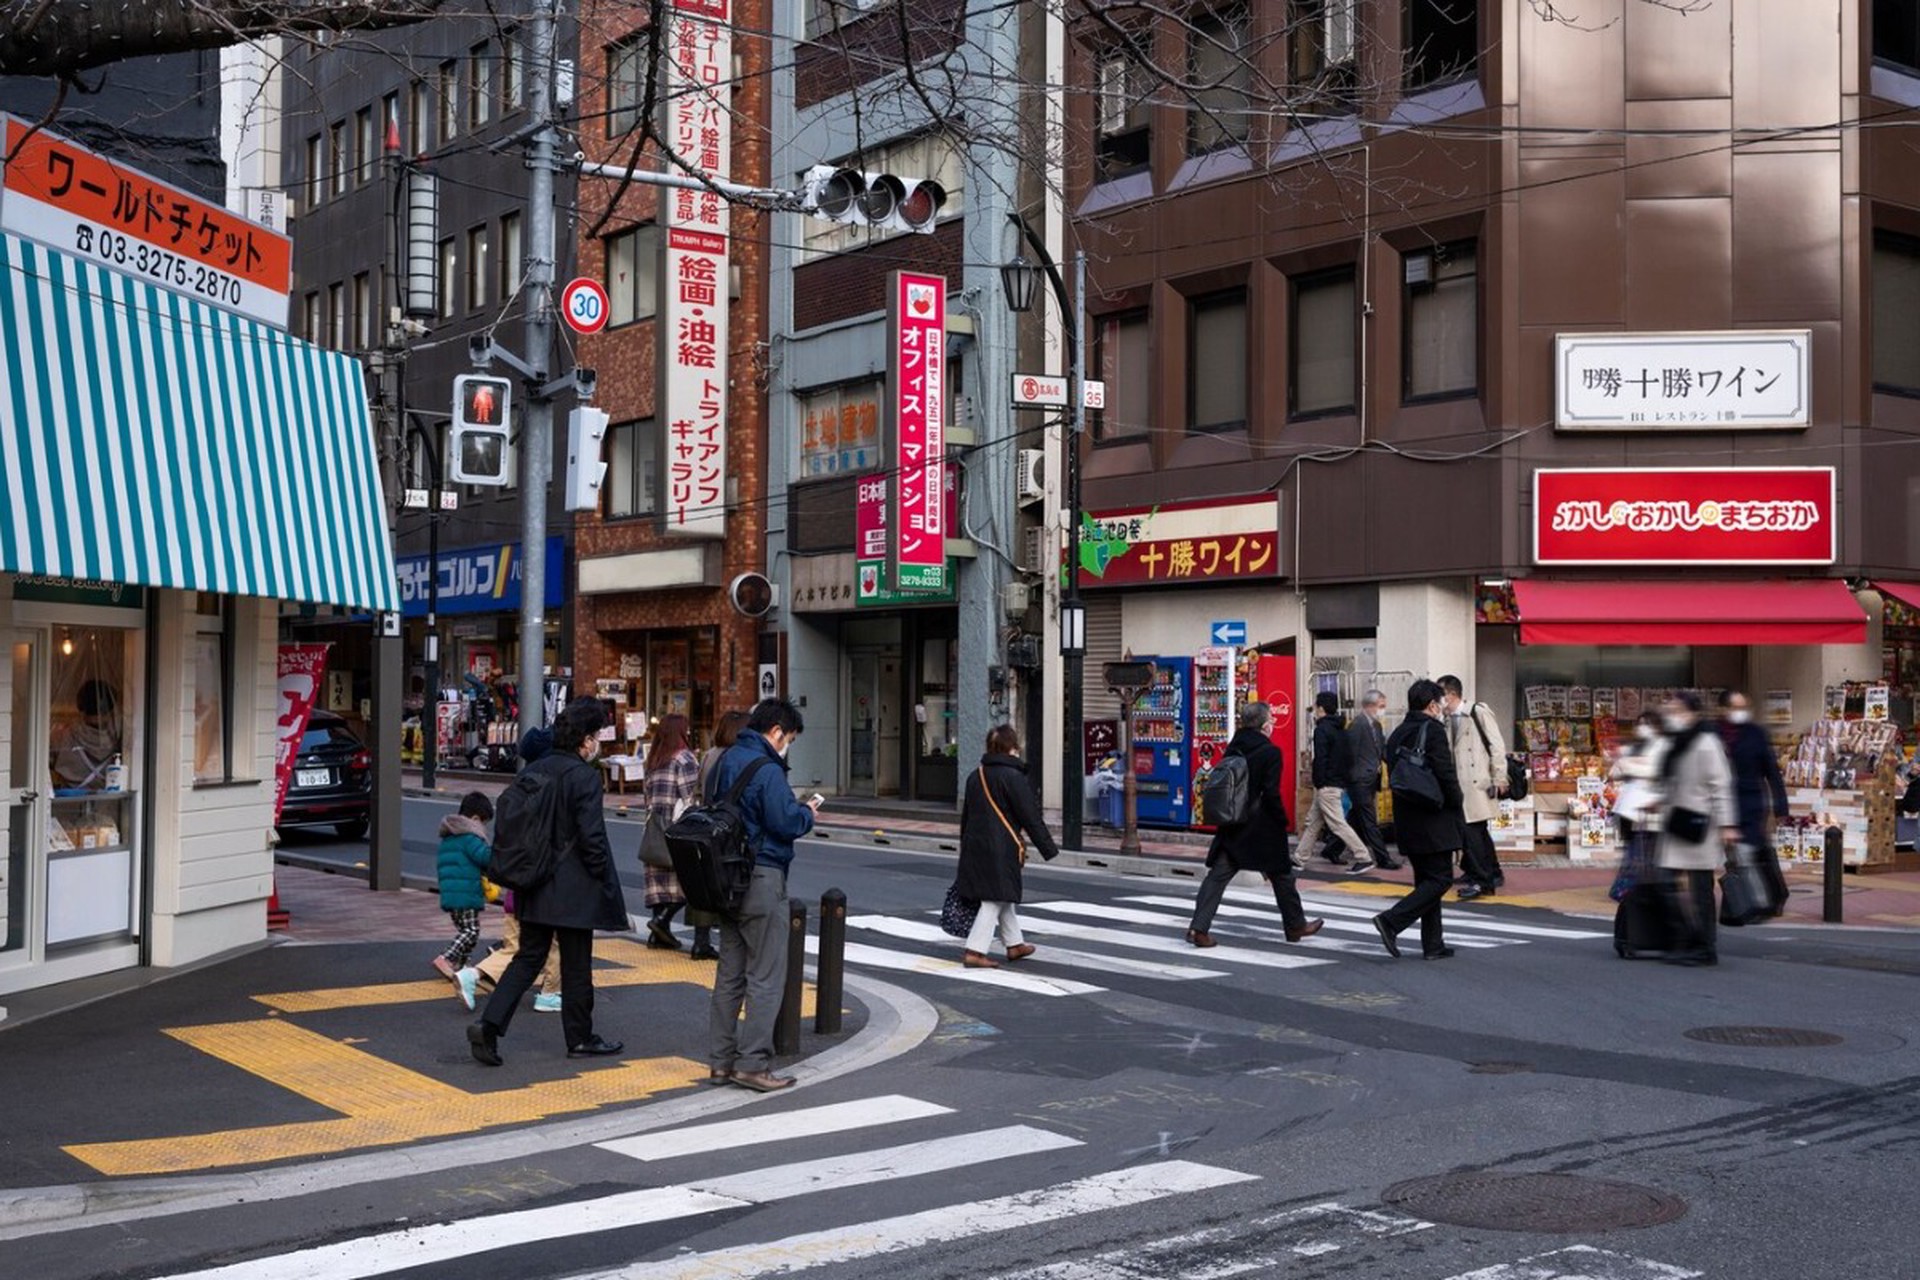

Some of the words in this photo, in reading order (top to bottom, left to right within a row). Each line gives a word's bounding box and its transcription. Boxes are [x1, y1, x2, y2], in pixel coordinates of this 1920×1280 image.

[48, 150, 262, 272] ワールドチケット
[99, 231, 241, 306] 03-3275-2870
[573, 293, 599, 319] 30
[678, 255, 717, 369] 絵画・油絵
[698, 378, 721, 505] トライアンフ
[902, 326, 924, 554] オフィス・マンション
[1086, 391, 1102, 406] 35
[671, 419, 695, 525] ギャラリー
[1139, 536, 1272, 580] 十勝ワイン
